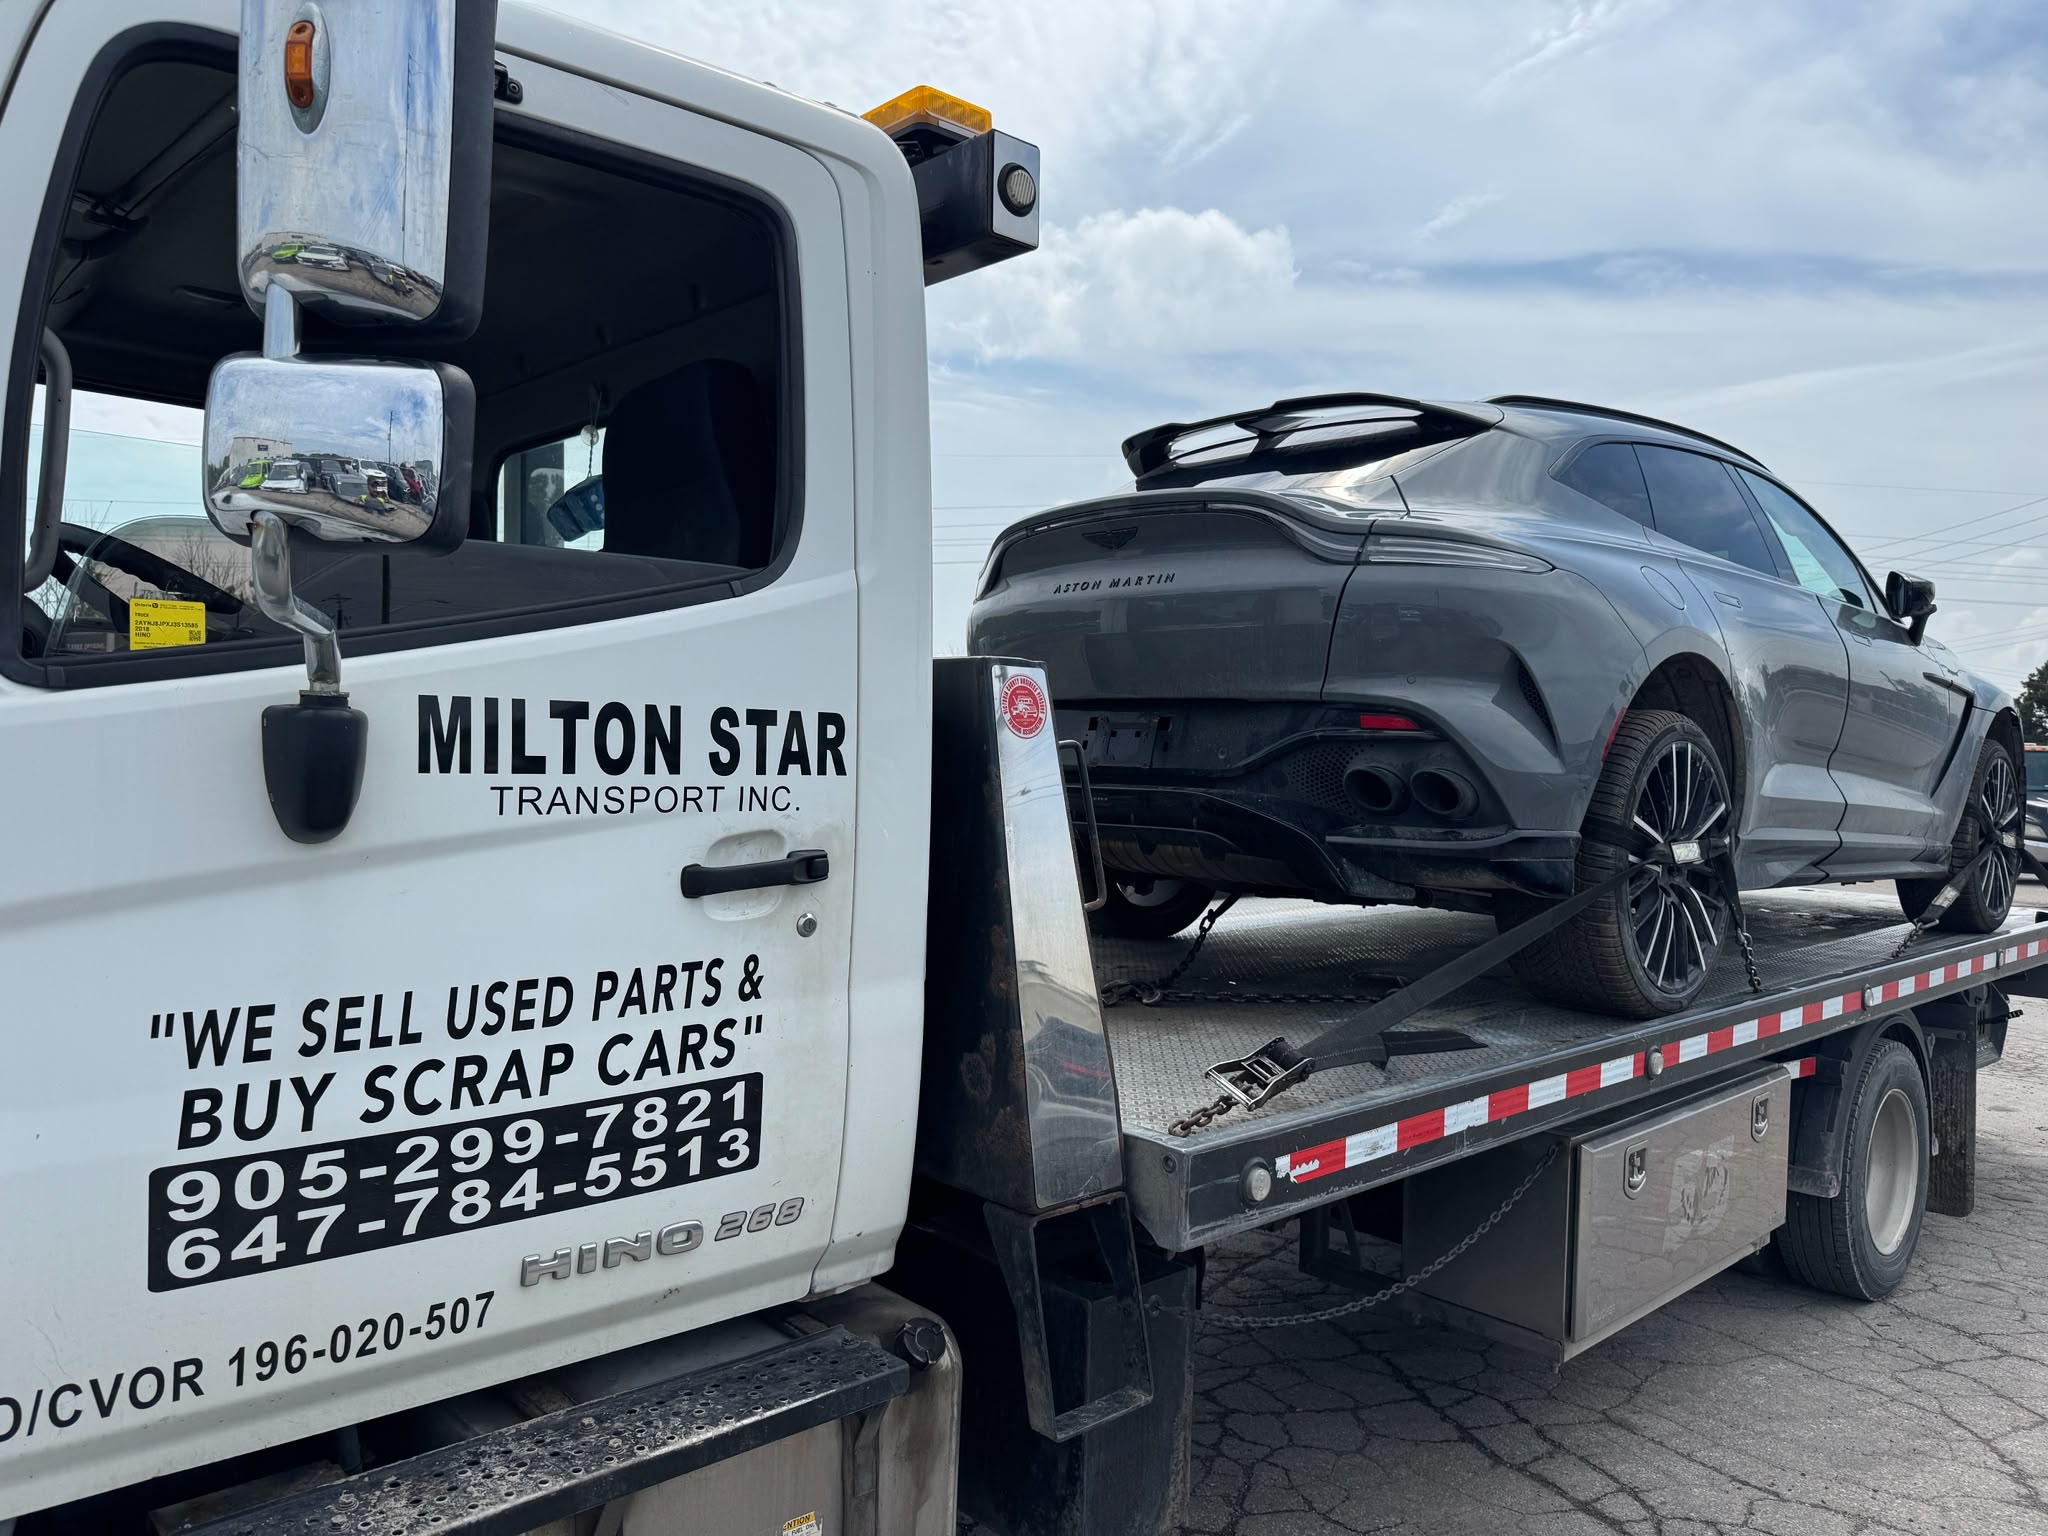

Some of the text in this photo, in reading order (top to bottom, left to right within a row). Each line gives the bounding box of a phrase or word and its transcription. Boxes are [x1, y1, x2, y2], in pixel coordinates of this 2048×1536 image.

[1053, 573, 1175, 595] ASTON MARTIN
[418, 694, 847, 776] MILTON STAR
[490, 786, 800, 816] TRANSPORT INC.
[149, 953, 763, 1069] "WE SELL USED PARTS &
[177, 1015, 764, 1150] BUY SCRAP CARS"
[166, 1088, 747, 1221] 905-299-7821
[167, 1130, 751, 1279] 647-784-5513
[520, 1197, 804, 1287] HINO 268
[228, 1290, 495, 1387] 196-020-507
